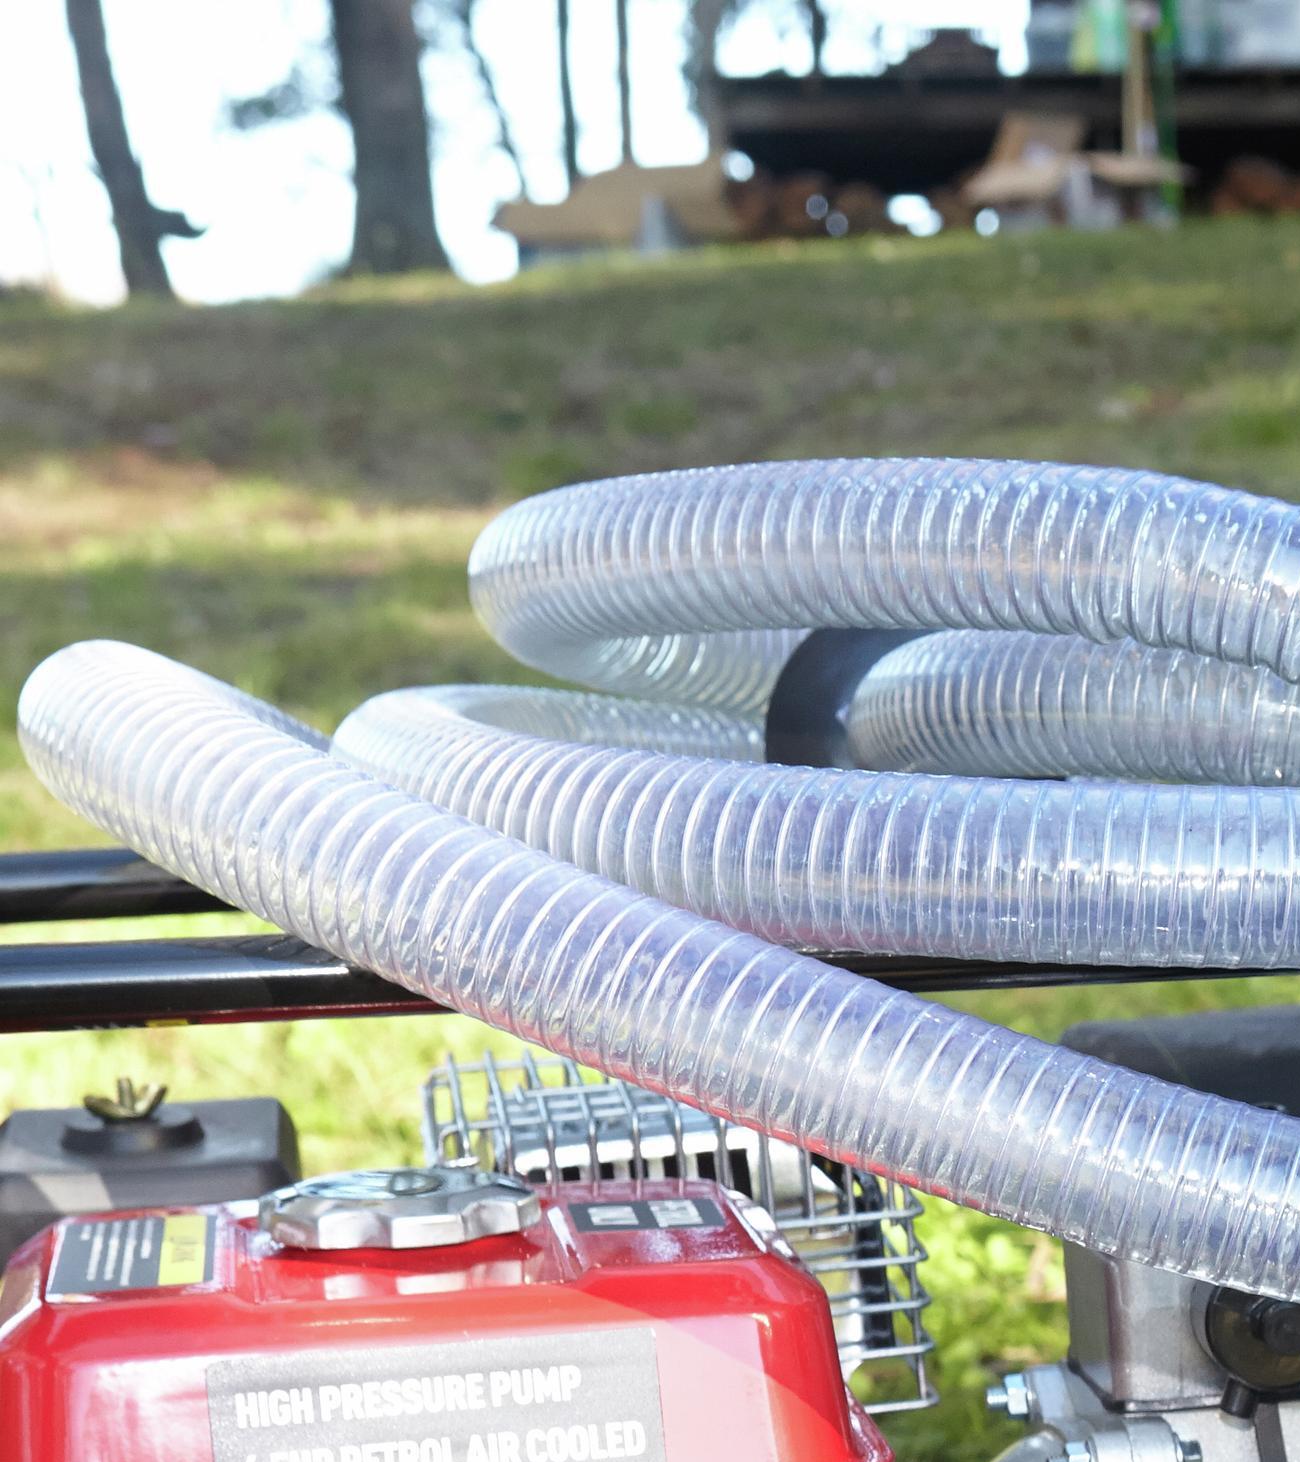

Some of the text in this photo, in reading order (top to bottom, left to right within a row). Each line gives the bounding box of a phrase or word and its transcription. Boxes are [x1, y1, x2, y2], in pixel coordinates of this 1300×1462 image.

[235, 1364, 582, 1429] HIGH PRESSURE PUMP
